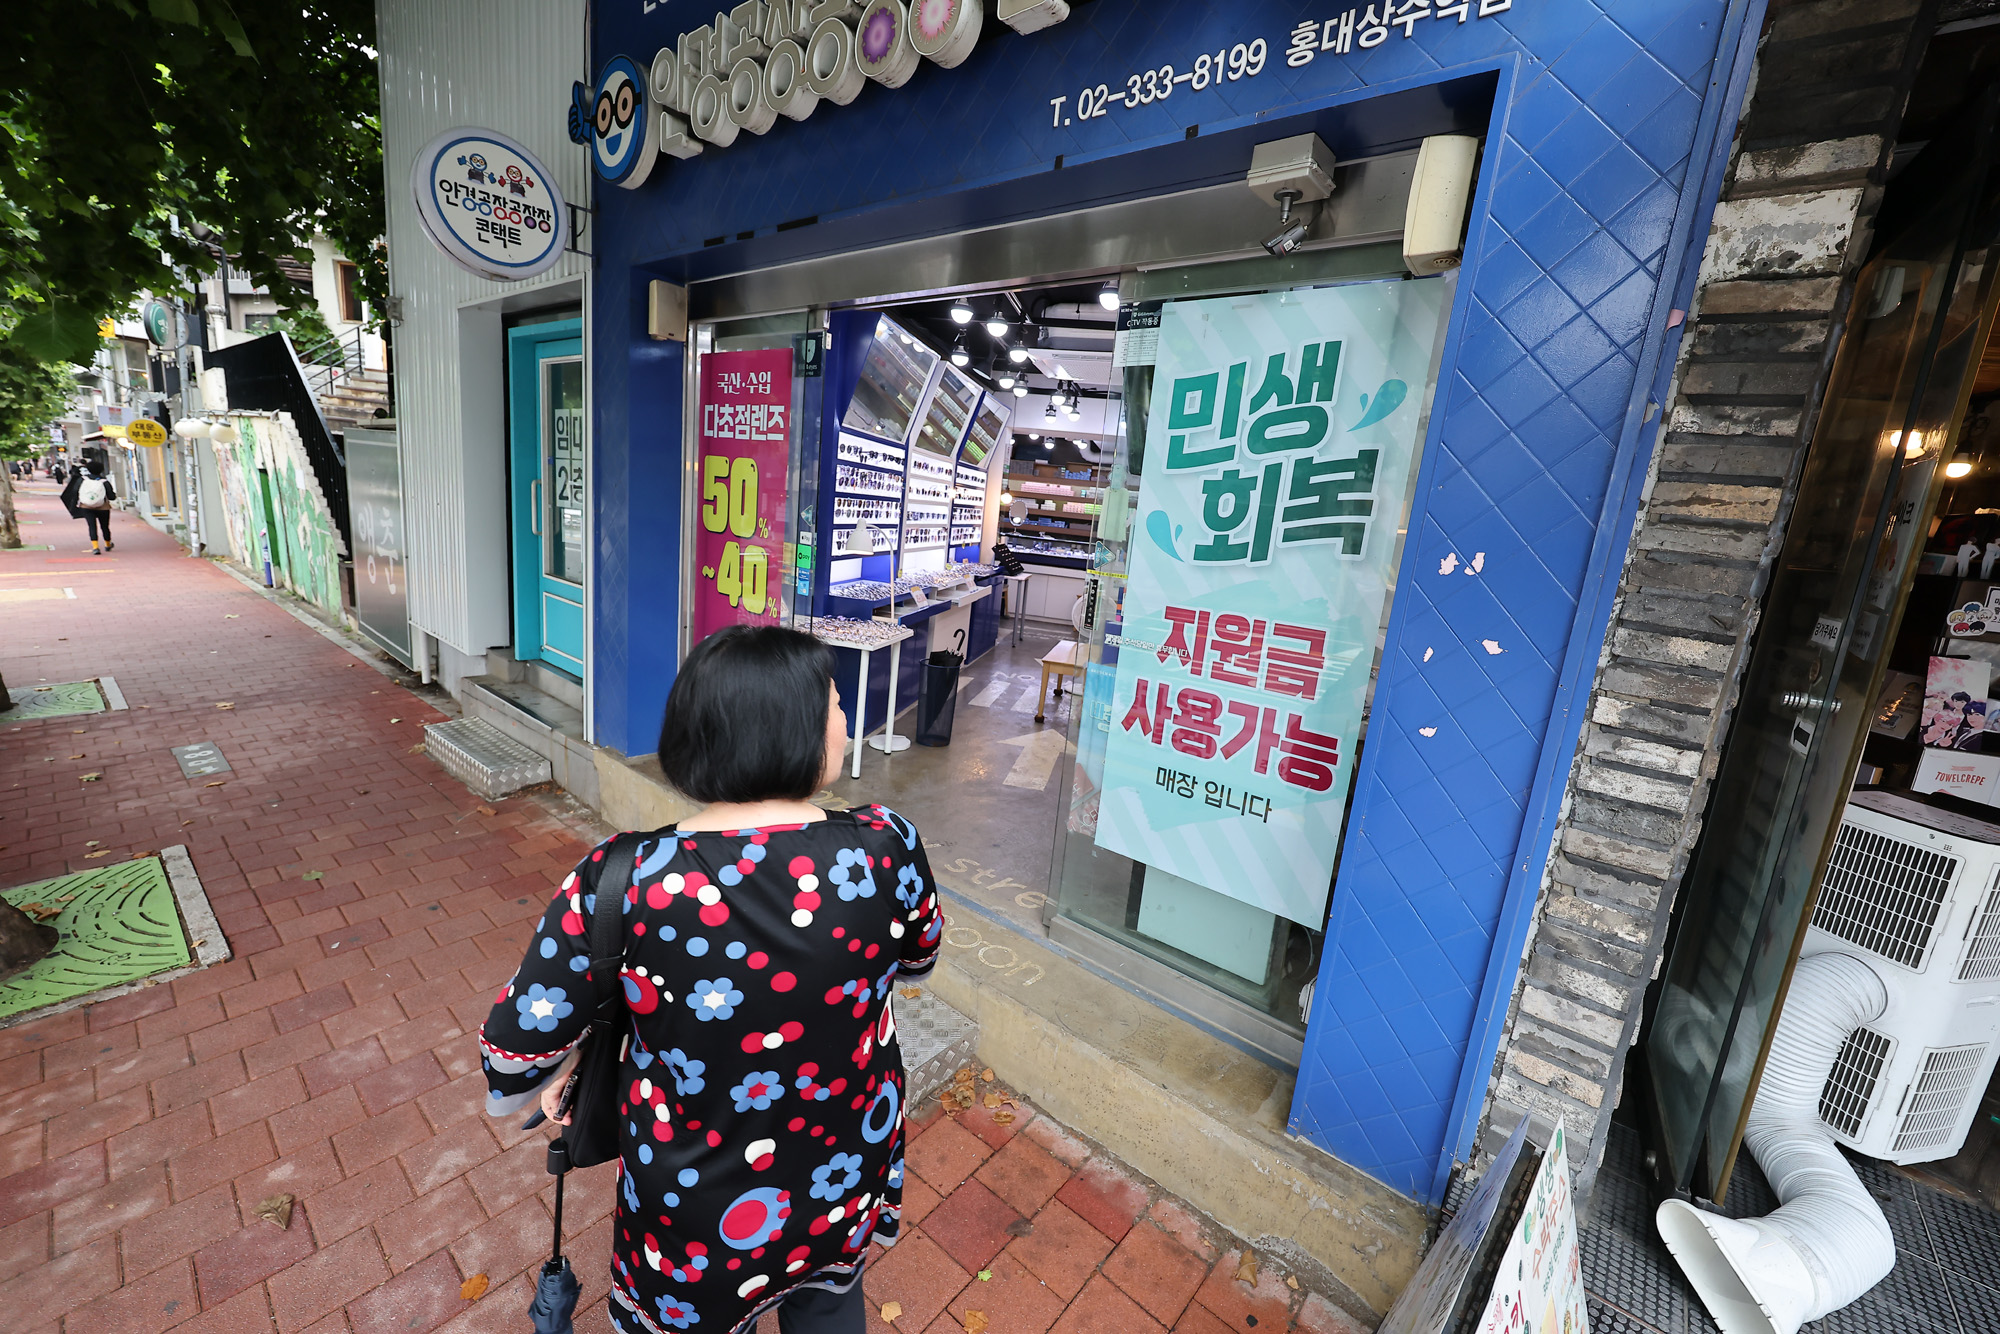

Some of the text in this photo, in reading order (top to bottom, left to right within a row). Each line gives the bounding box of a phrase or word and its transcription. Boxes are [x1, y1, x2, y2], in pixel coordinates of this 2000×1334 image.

[1077, 37, 1268, 121] 02-333-8199
[439, 179, 552, 233] 안경공장공장장
[475, 217, 522, 248] 콘택트
[704, 403, 785, 441] 다초점렌즈
[1165, 339, 1343, 470] 민생
[1193, 449, 1380, 563] 회복
[1156, 605, 1328, 701] 지원금
[1120, 678, 1339, 792] 사용가능
[1155, 766, 1273, 823] 매장 입니다
[1935, 771, 1986, 786] TOWELCREPE
